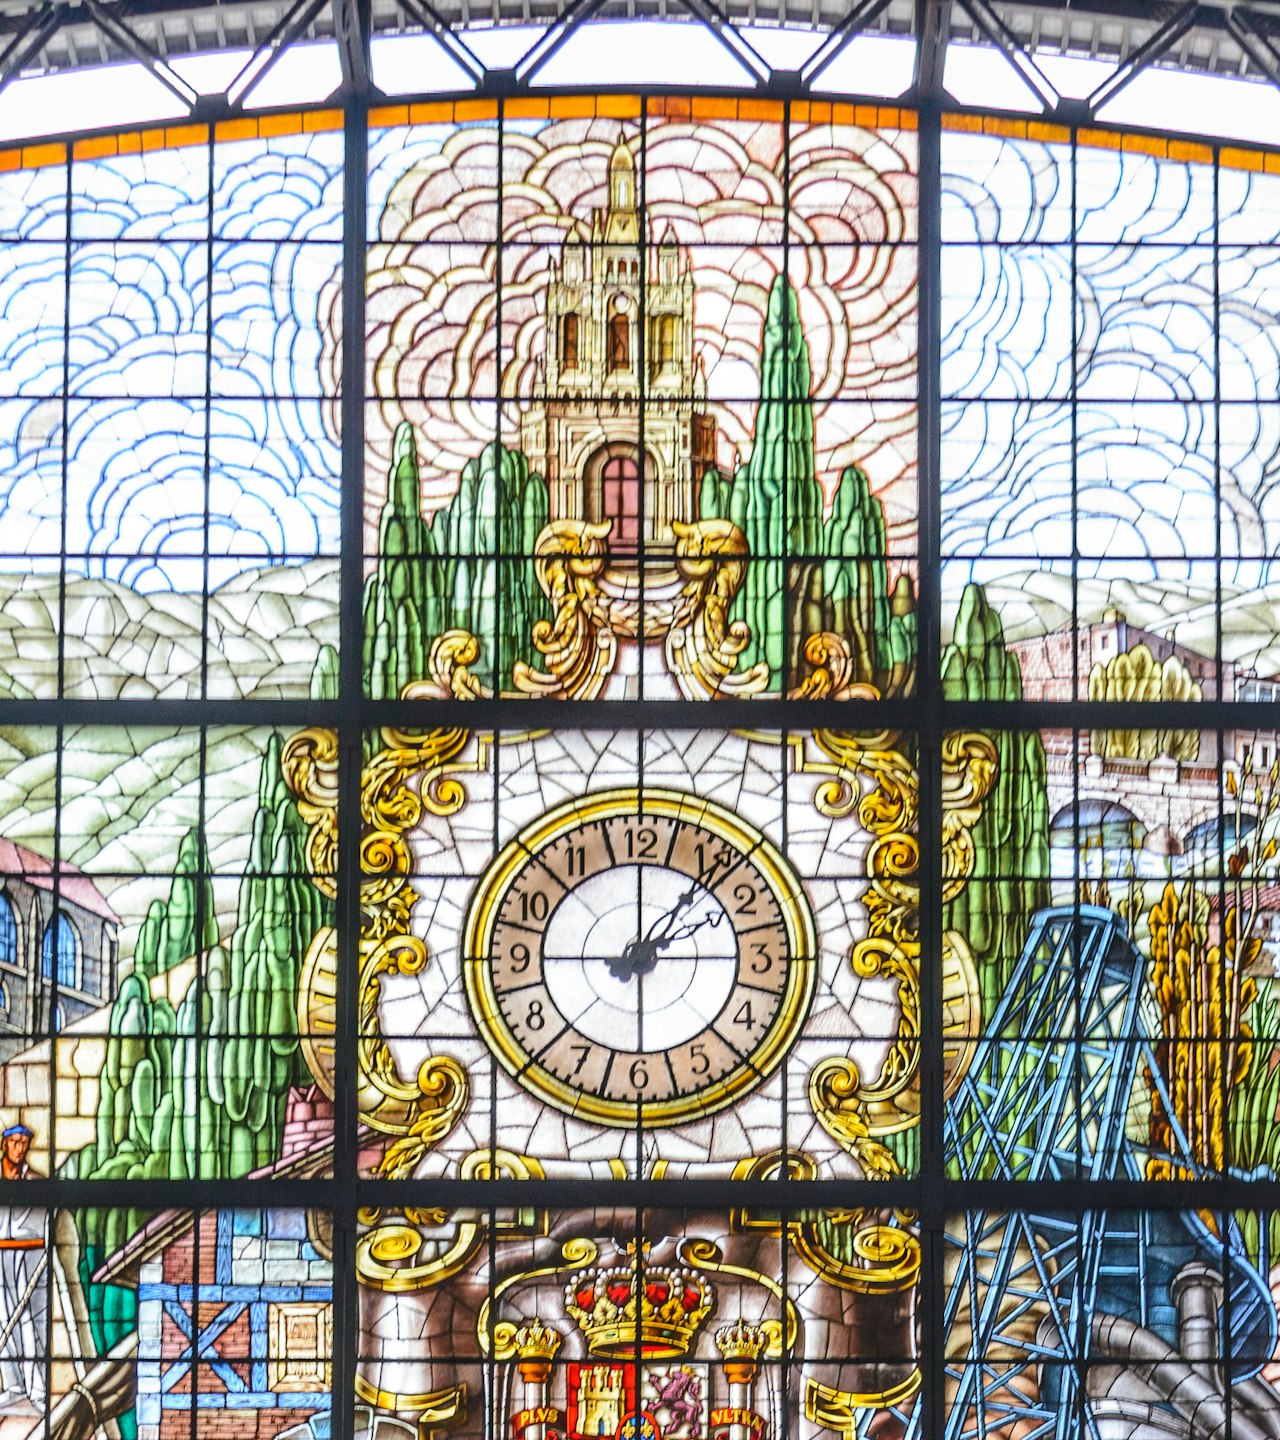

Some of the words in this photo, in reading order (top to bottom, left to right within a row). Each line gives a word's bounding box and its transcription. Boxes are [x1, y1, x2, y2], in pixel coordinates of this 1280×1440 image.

[625, 828, 658, 858] 12
[564, 846, 586, 877] 11
[518, 892, 549, 922] 10
[734, 884, 757, 915] 2
[509, 943, 531, 972] 9
[749, 943, 773, 973] 3
[525, 1000, 545, 1031] 8
[732, 1000, 756, 1030] 4
[570, 1045, 593, 1075] 7
[628, 1058, 649, 1089] 6
[690, 1044, 710, 1075] 5
